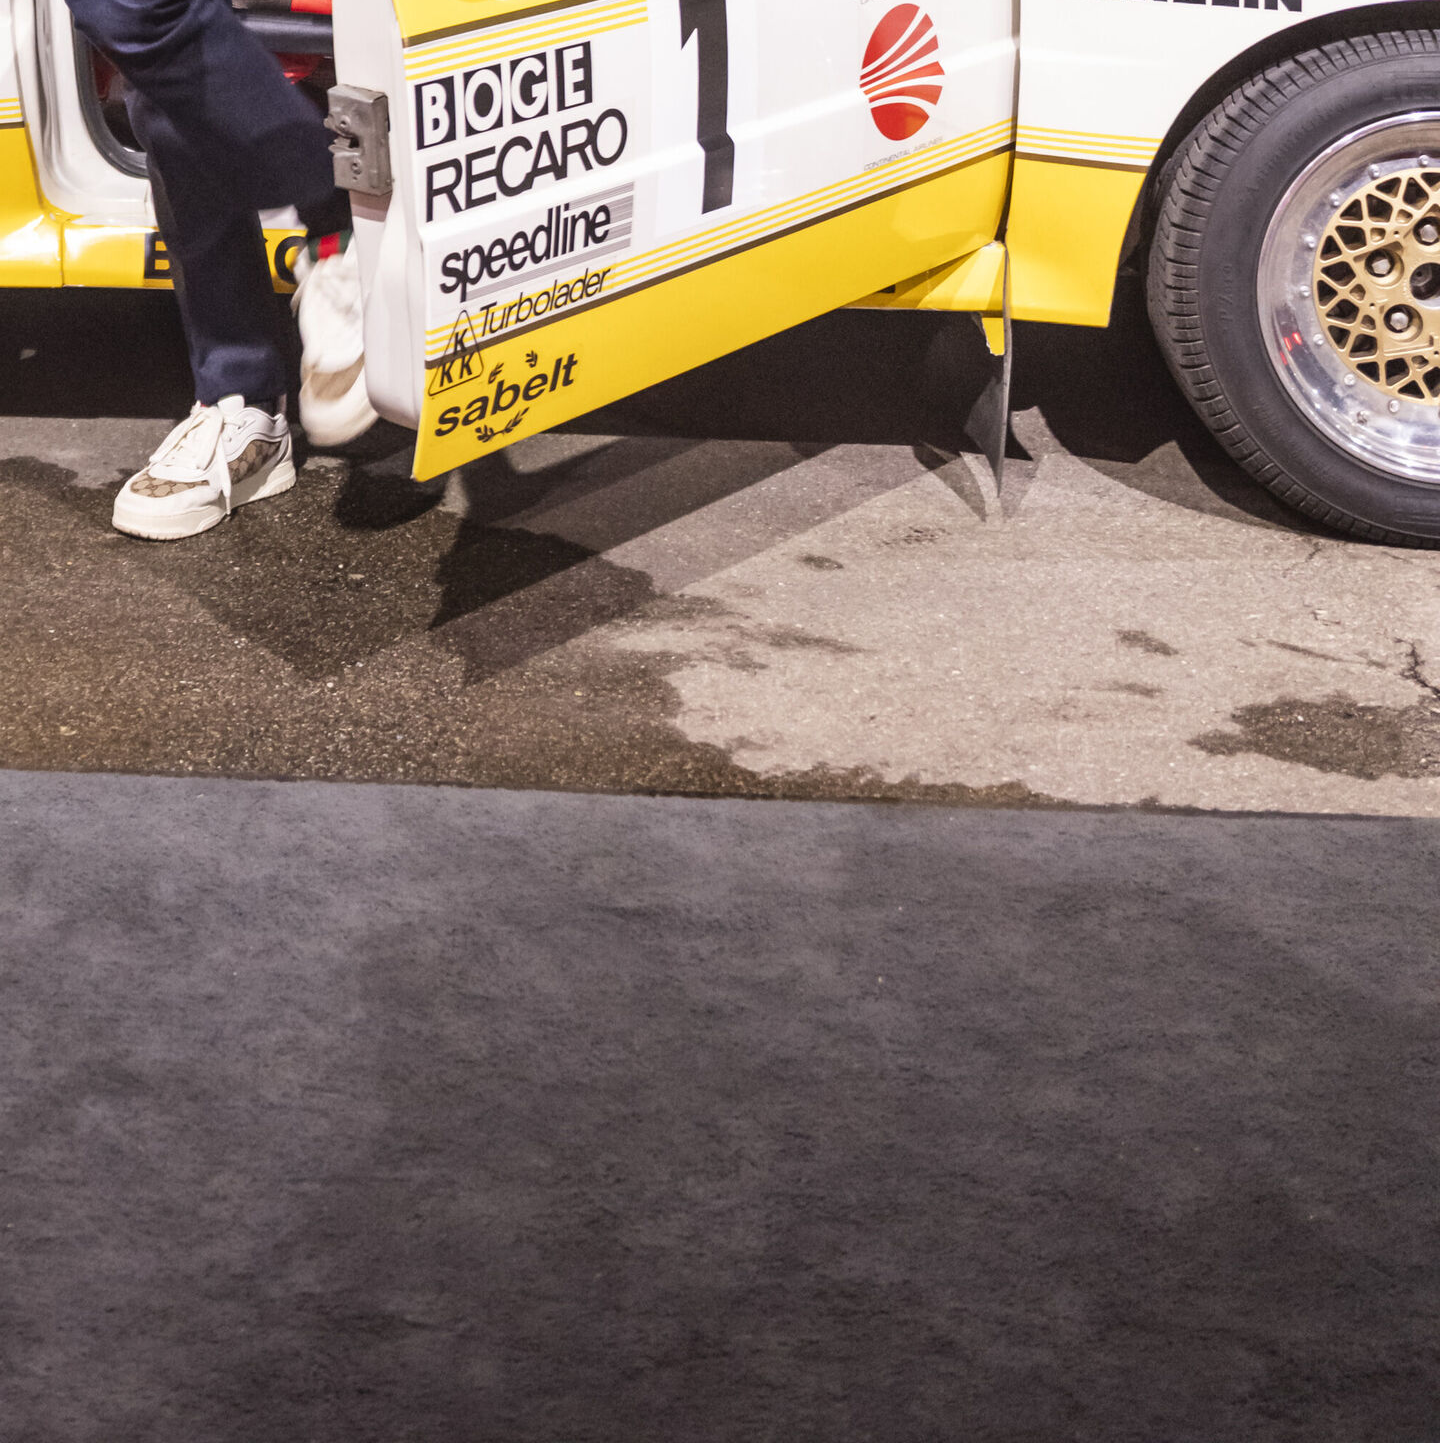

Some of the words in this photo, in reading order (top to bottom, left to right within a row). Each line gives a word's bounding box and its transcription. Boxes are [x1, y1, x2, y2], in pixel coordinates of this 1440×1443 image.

[420, 44, 588, 148] BOGE
[426, 108, 628, 223] RECARO
[439, 202, 611, 303] speedline
[479, 267, 612, 338] Turbolader
[434, 352, 579, 437] sabelt
